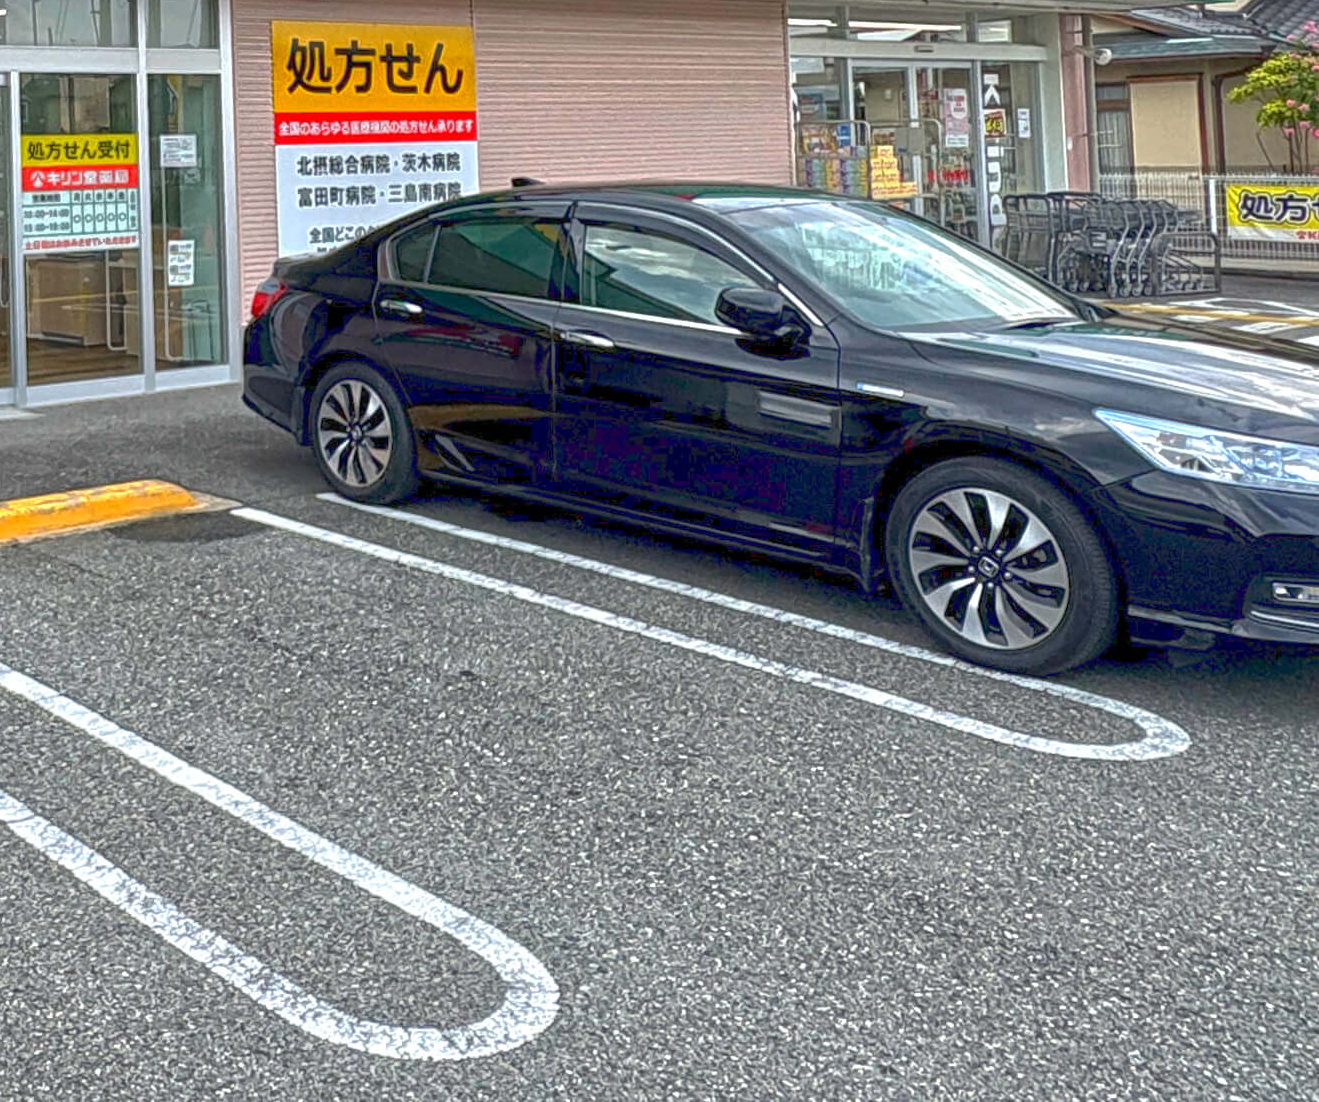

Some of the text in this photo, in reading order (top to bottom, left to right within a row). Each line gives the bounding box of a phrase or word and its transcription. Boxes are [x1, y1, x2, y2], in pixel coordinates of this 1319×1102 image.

[286, 37, 464, 95] 処方せん
[27, 140, 131, 159] 処方せん受付
